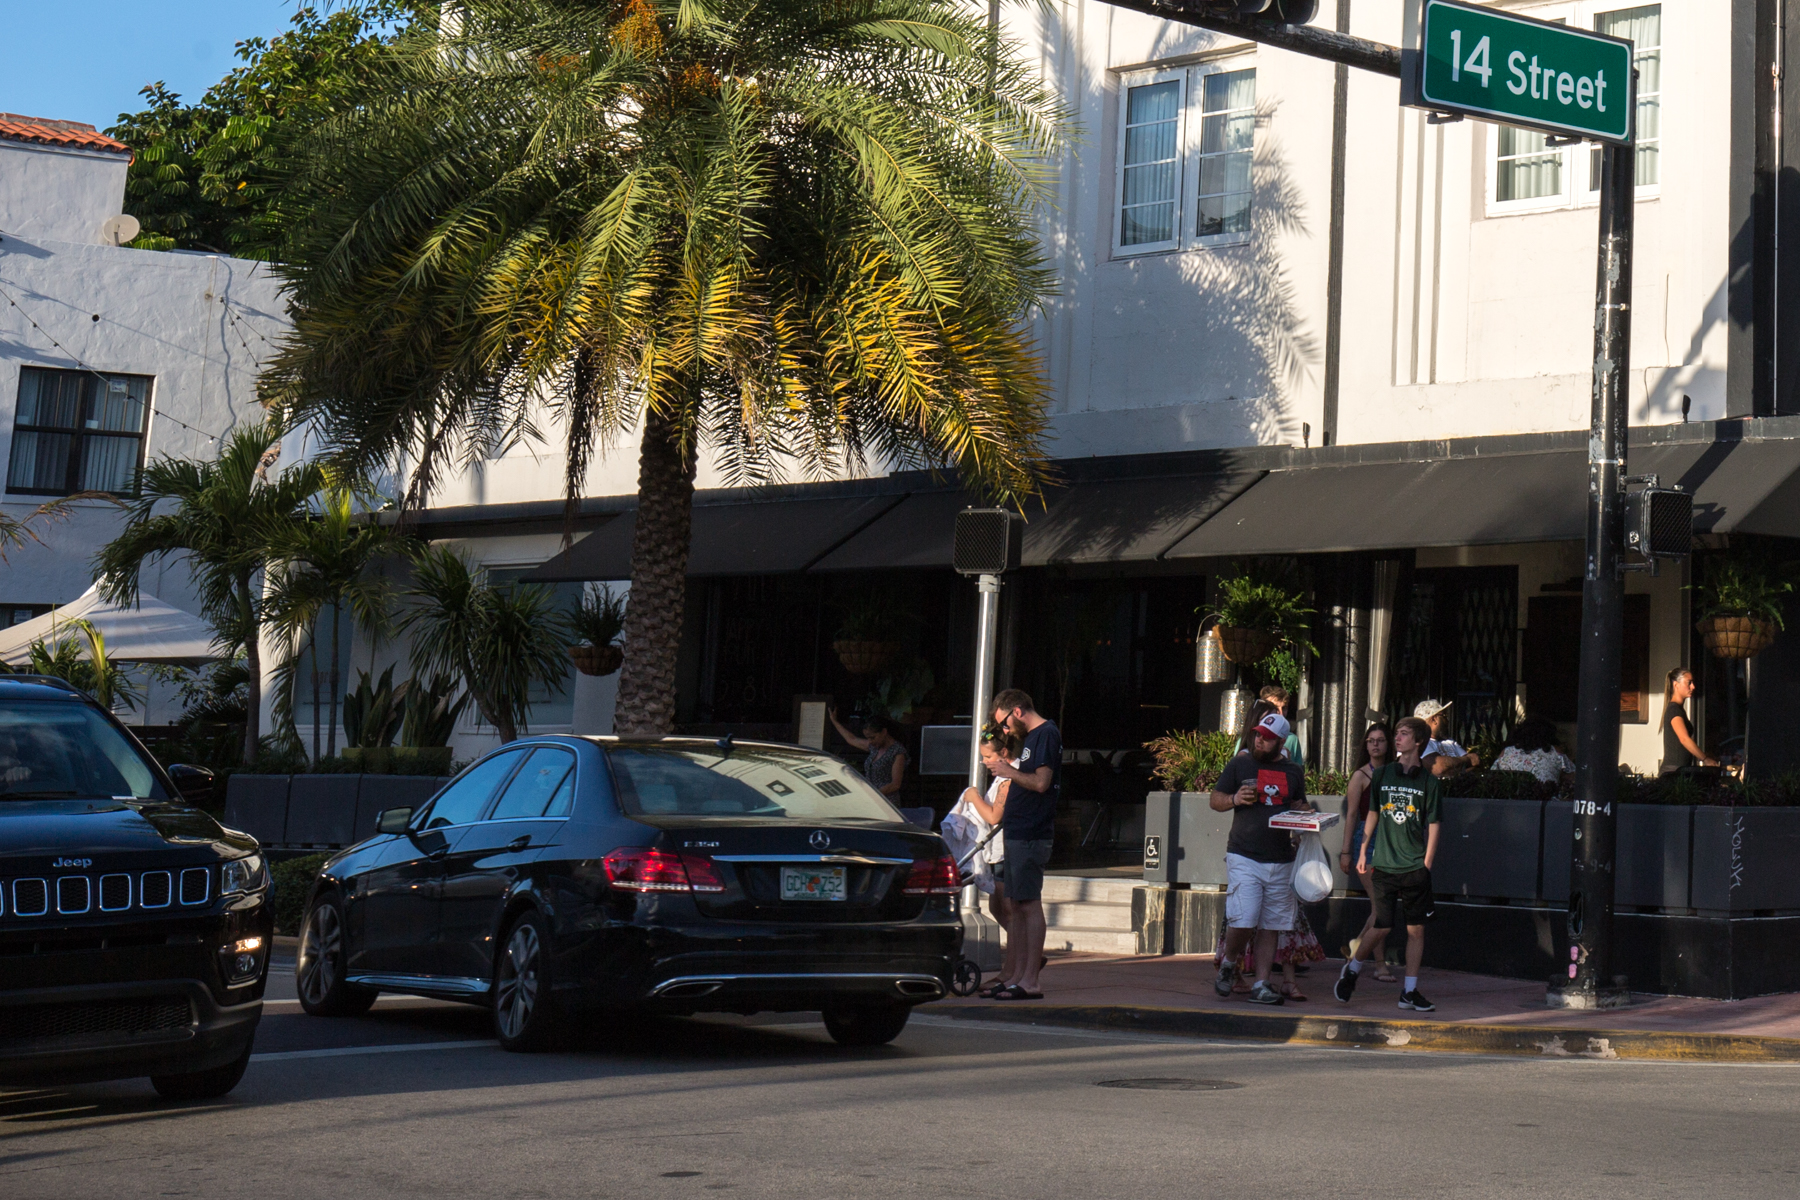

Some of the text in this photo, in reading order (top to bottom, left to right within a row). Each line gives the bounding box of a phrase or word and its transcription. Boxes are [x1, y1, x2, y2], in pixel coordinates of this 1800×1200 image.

[1450, 29, 1607, 113] 14 Street
[1398, 786, 1424, 796] GROVE
[1573, 799, 1611, 816] 078-4
[52, 857, 92, 868] Jeep
